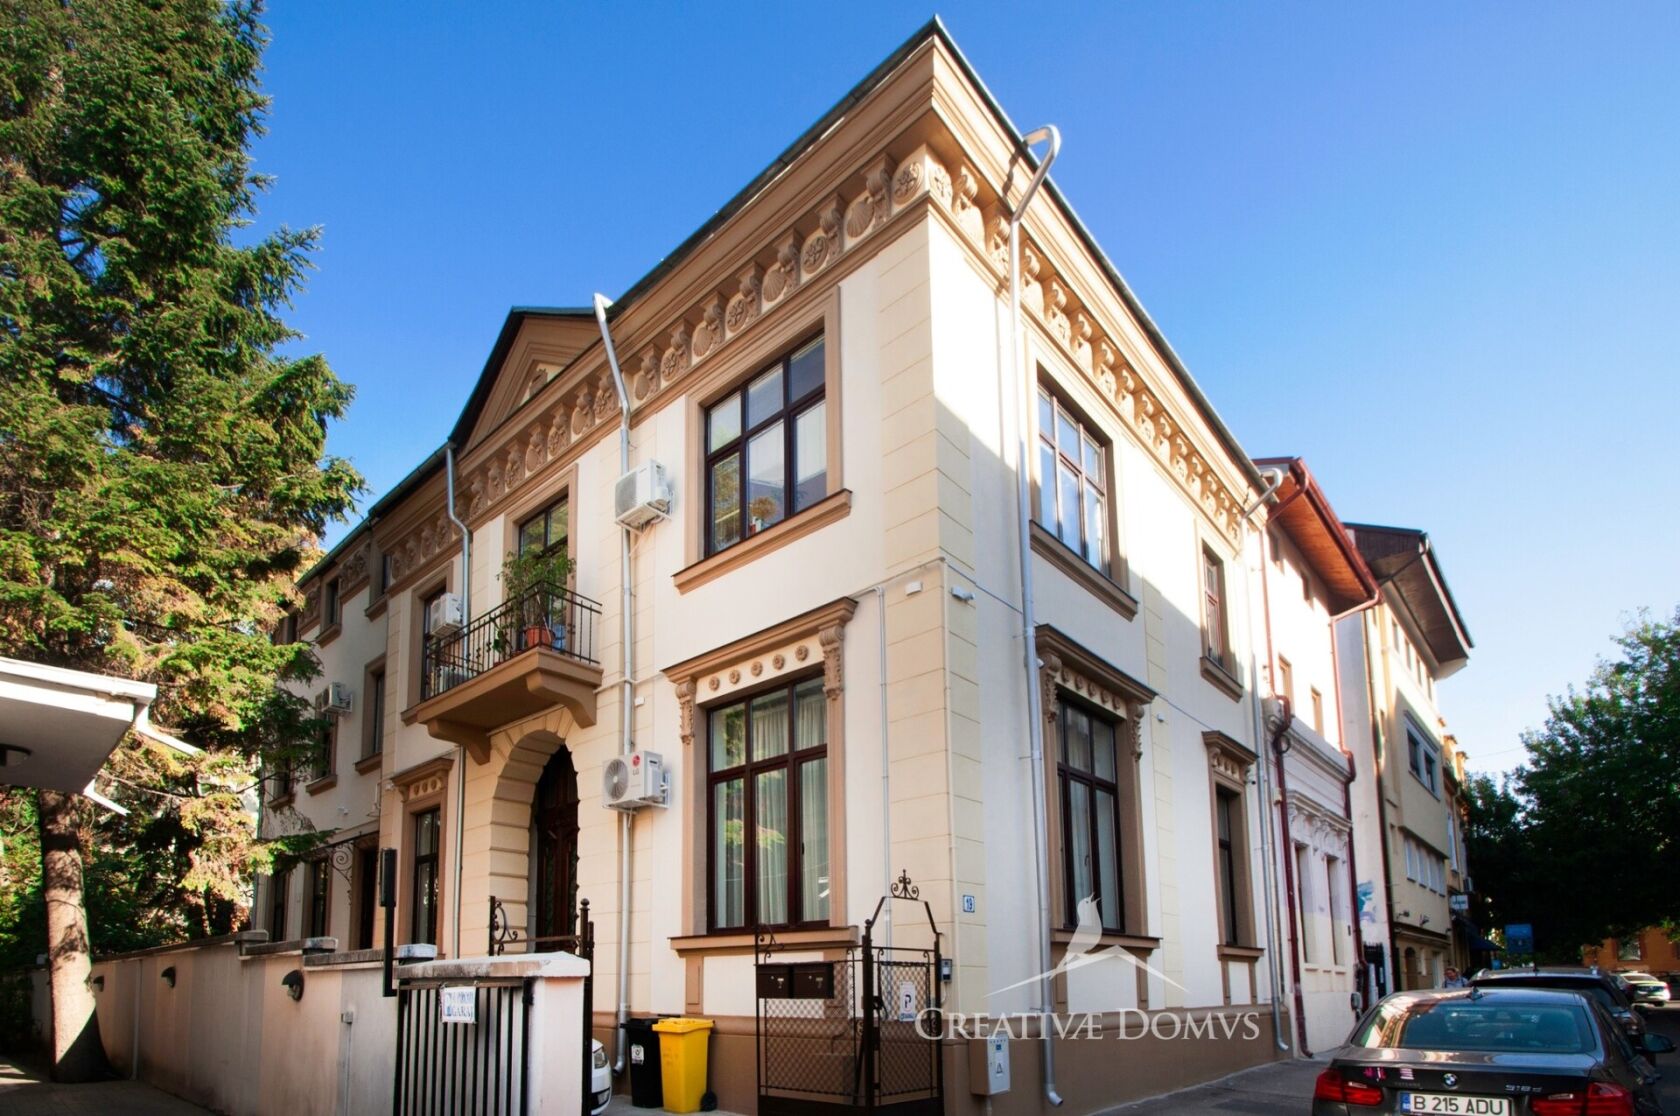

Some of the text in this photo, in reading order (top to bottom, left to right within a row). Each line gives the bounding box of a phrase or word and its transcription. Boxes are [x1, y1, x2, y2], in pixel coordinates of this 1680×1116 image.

[1413, 1095, 1426, 1110] B
[1431, 1096, 1459, 1113] 215
[1465, 1098, 1503, 1116] ADU
